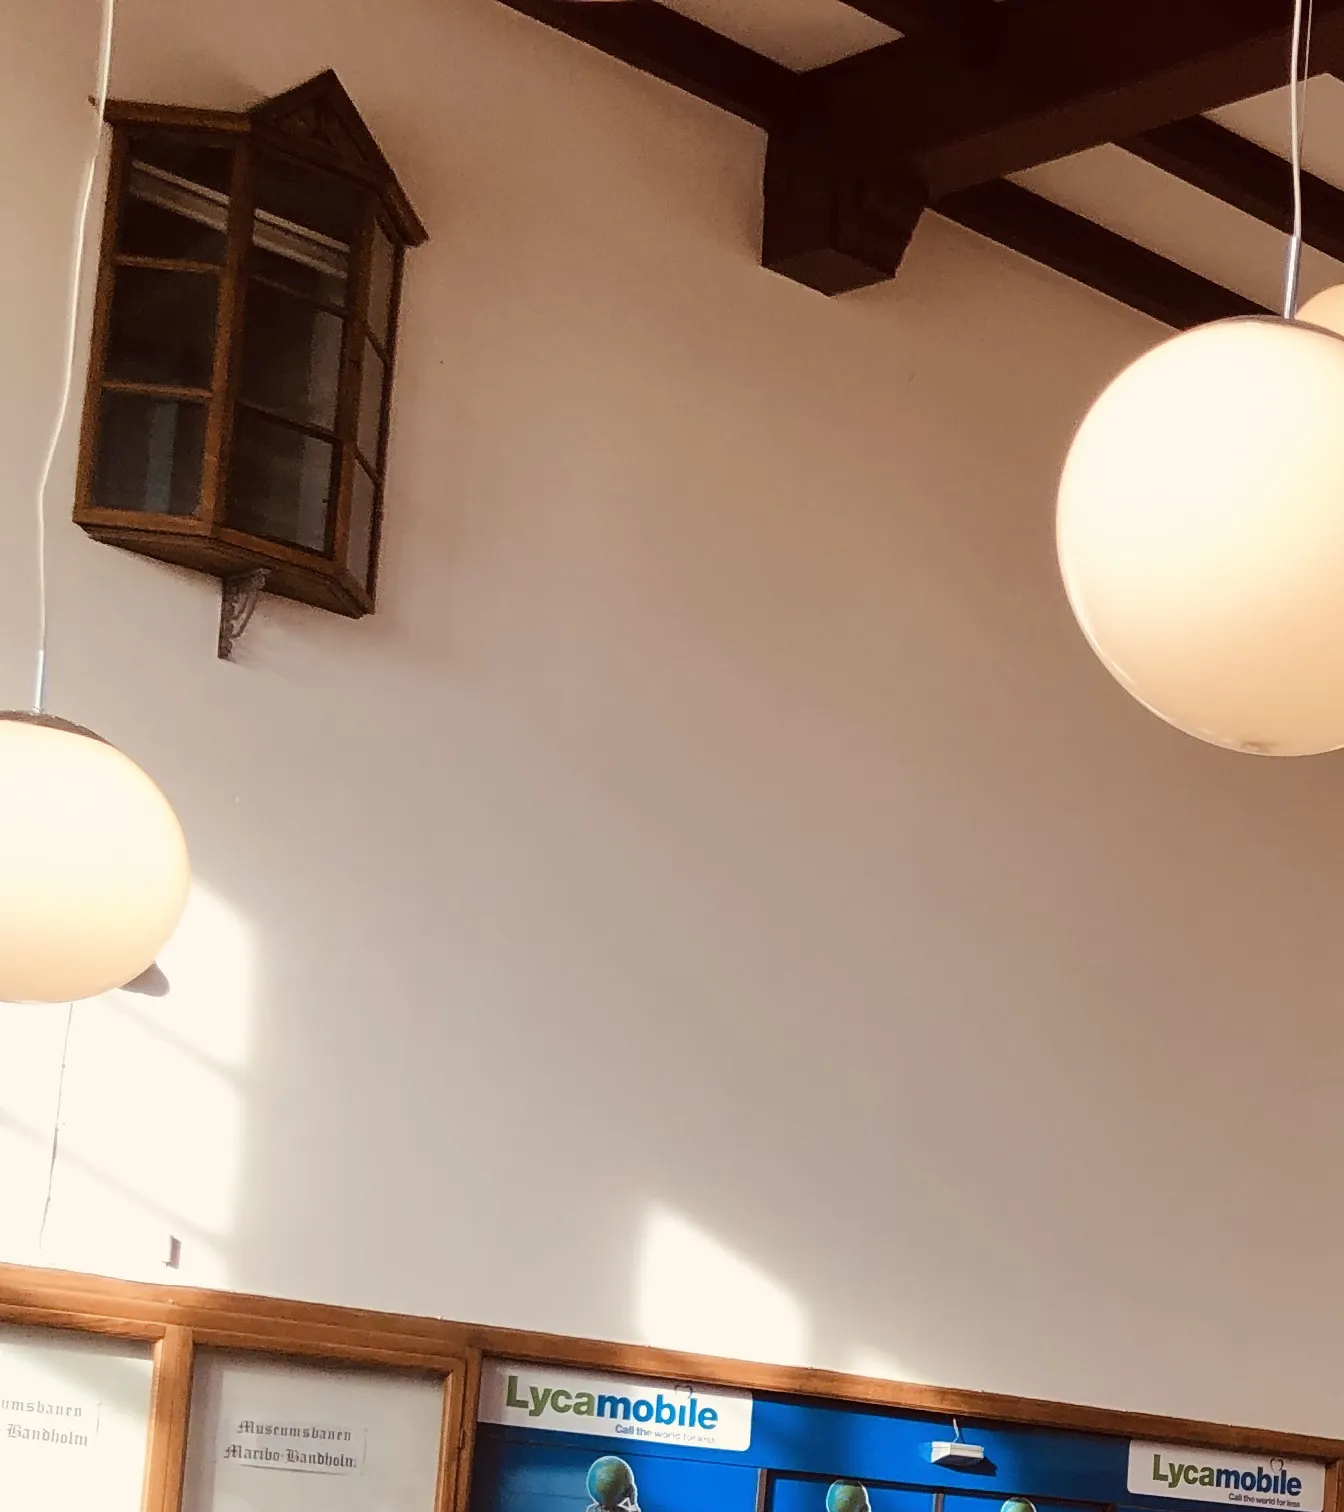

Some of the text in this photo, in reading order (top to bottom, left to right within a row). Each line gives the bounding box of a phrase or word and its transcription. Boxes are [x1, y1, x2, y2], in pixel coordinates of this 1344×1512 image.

[506, 1376, 718, 1430] Lycamobile
[238, 1420, 352, 1441] Museumsbanen
[1153, 1454, 1302, 1496] Lycamobile
[1228, 1493, 1243, 1502] Call
[1244, 1494, 1256, 1503] the
